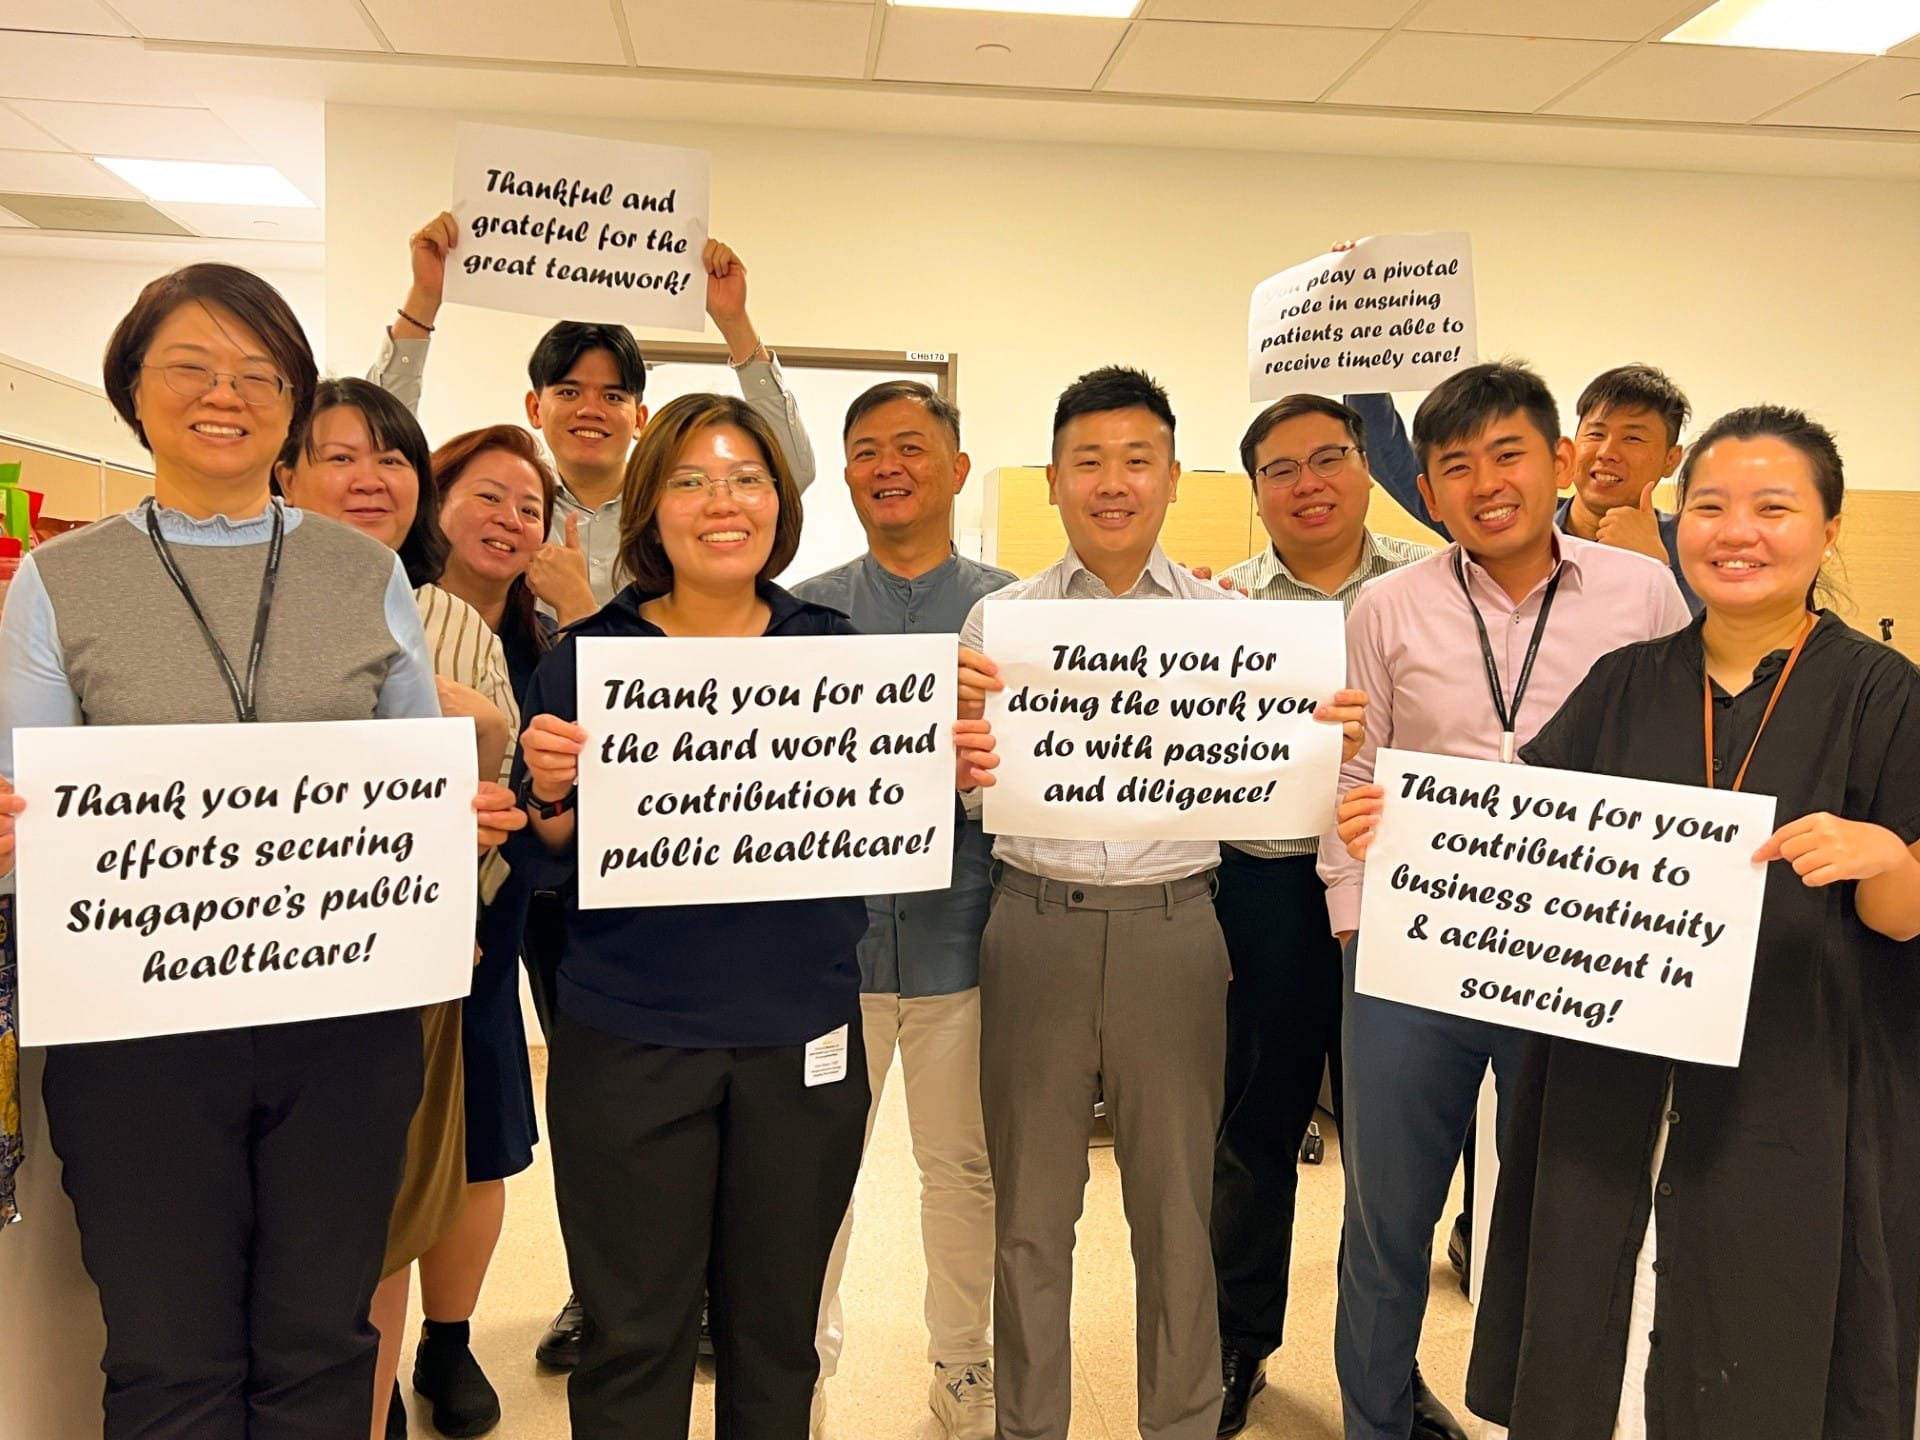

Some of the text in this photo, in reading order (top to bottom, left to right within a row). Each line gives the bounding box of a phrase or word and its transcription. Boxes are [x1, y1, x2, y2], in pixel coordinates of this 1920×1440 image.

[486, 169, 676, 214] Thankful and
[471, 214, 687, 254] grateful for the
[463, 254, 691, 296] great teamwork!
[1306, 268, 1356, 292] play
[1362, 267, 1377, 281] a
[1383, 258, 1459, 283] pivotal
[1280, 289, 1441, 320] role in ensuring
[1260, 316, 1464, 353] patients are able to
[1265, 345, 1461, 375] receive timely care!
[1052, 644, 1277, 678] Thank you for
[604, 673, 936, 716] Thank you for all
[1008, 686, 1318, 722] doing the work you
[601, 723, 938, 764] the hard work and
[1033, 730, 1290, 767] do with passion
[54, 775, 447, 820] Thank you for your
[637, 777, 904, 817] contribution to
[1044, 775, 1277, 811] and diligence!
[1401, 772, 1739, 843] Thank you for your
[96, 826, 413, 881] efforts securing
[600, 826, 936, 878] public healthcare!
[1431, 832, 1690, 886] contribution to
[67, 874, 439, 937] Singapore's public
[1391, 863, 1726, 947] business continuity
[142, 932, 377, 983] healthcare!
[1407, 913, 1693, 988] & achievement in
[1460, 977, 1624, 1029] sourcing!
